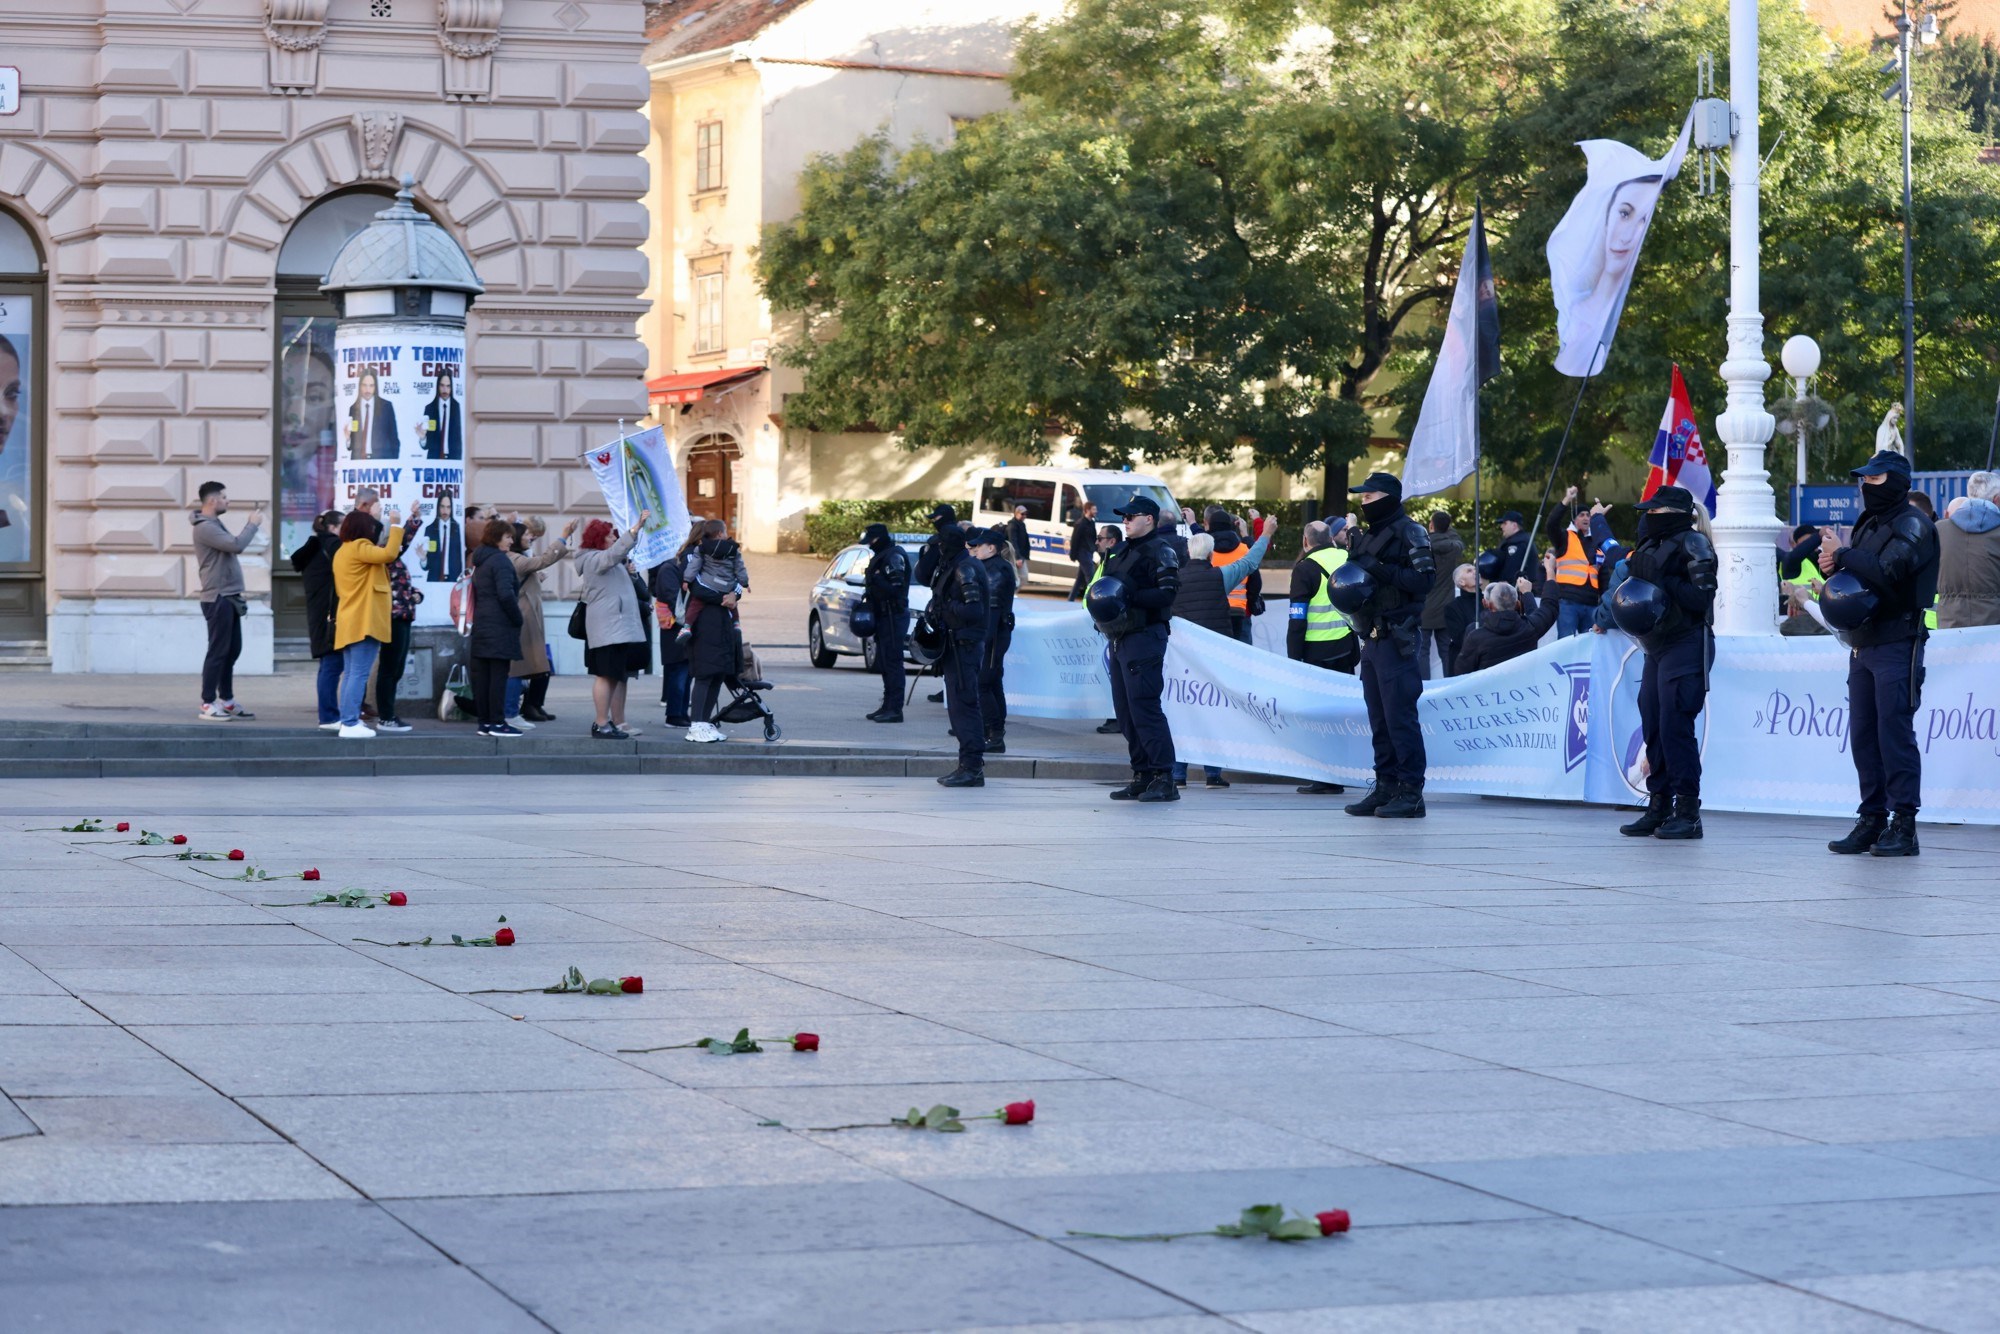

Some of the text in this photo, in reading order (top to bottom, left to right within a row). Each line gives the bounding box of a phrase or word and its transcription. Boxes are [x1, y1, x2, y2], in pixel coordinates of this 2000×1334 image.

[342, 346, 402, 363] TOMMY
[411, 346, 464, 363] TOMMY
[342, 468, 403, 484] TOMMY
[412, 468, 463, 484] TOMMY
[347, 484, 392, 499] CH
[1426, 682, 1559, 712] VITEZOVI
[1440, 707, 1559, 732] BEZGREŠNOG
[1453, 732, 1557, 752] SRCA MARIJINA
